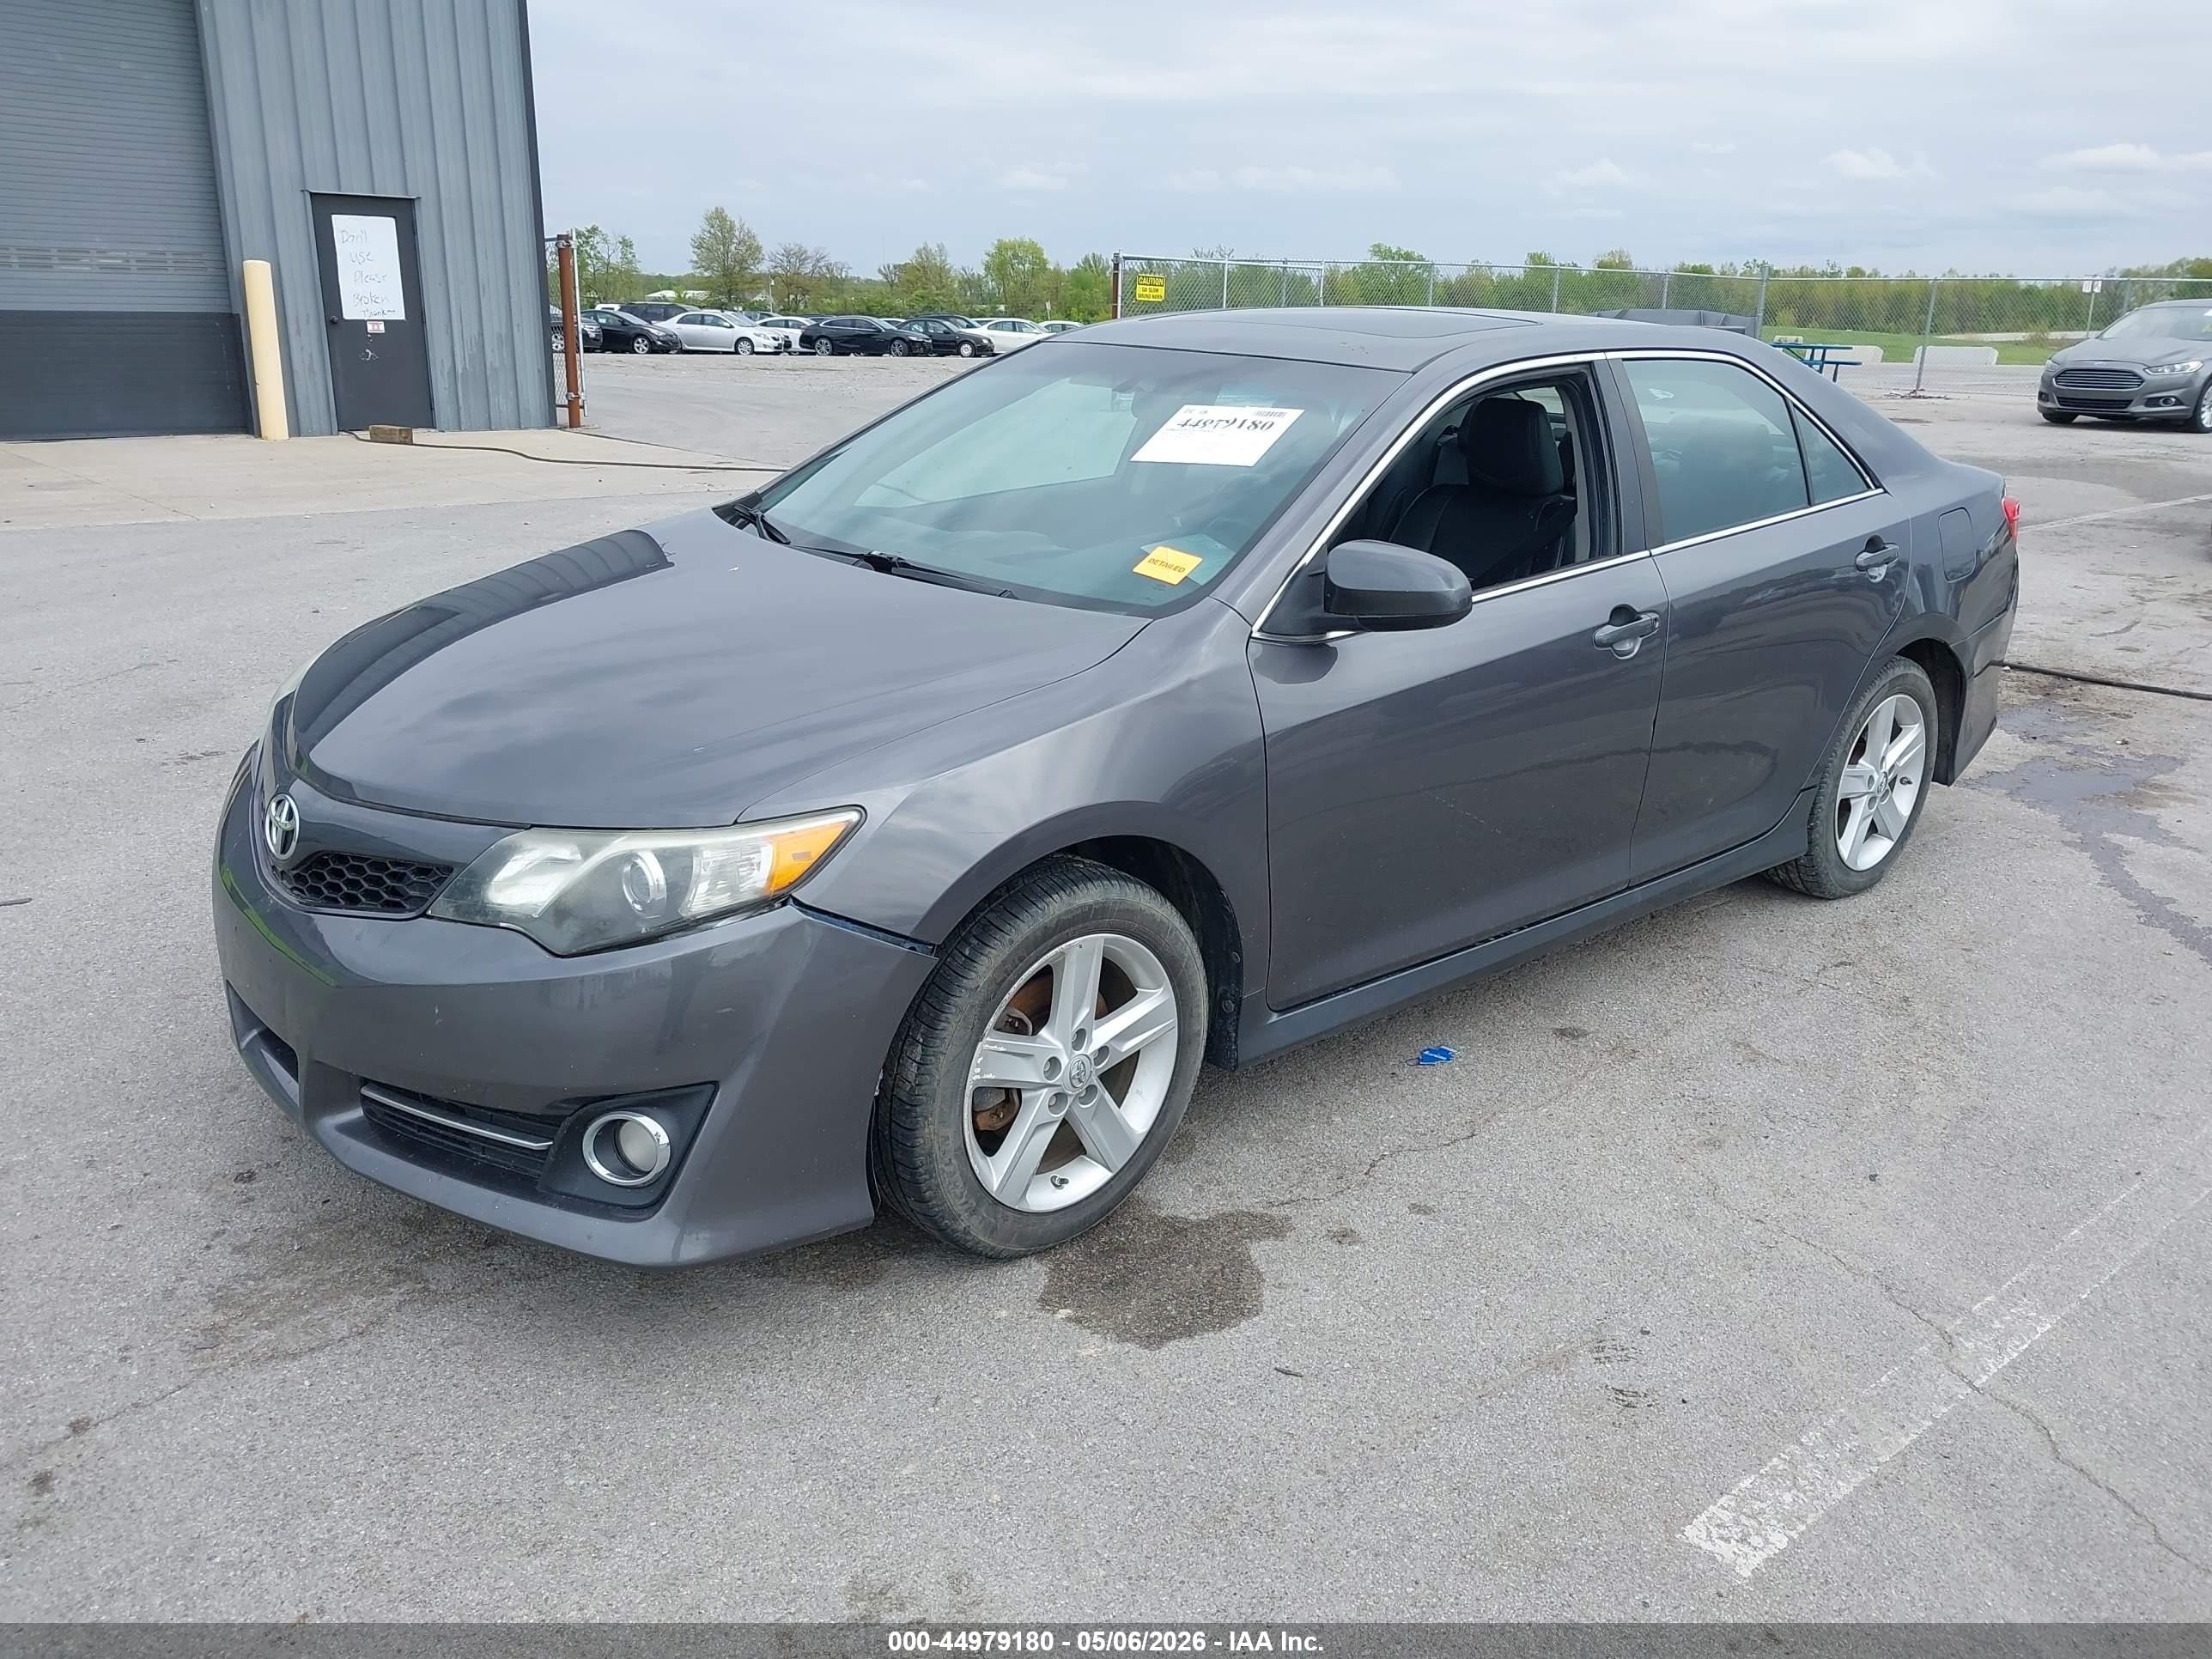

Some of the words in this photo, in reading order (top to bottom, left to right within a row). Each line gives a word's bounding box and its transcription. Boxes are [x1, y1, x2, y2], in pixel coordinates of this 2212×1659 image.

[1139, 276, 1164, 286] CAUTION
[1177, 417, 1275, 431] 44979180
[1147, 557, 1186, 574] DETAILED
